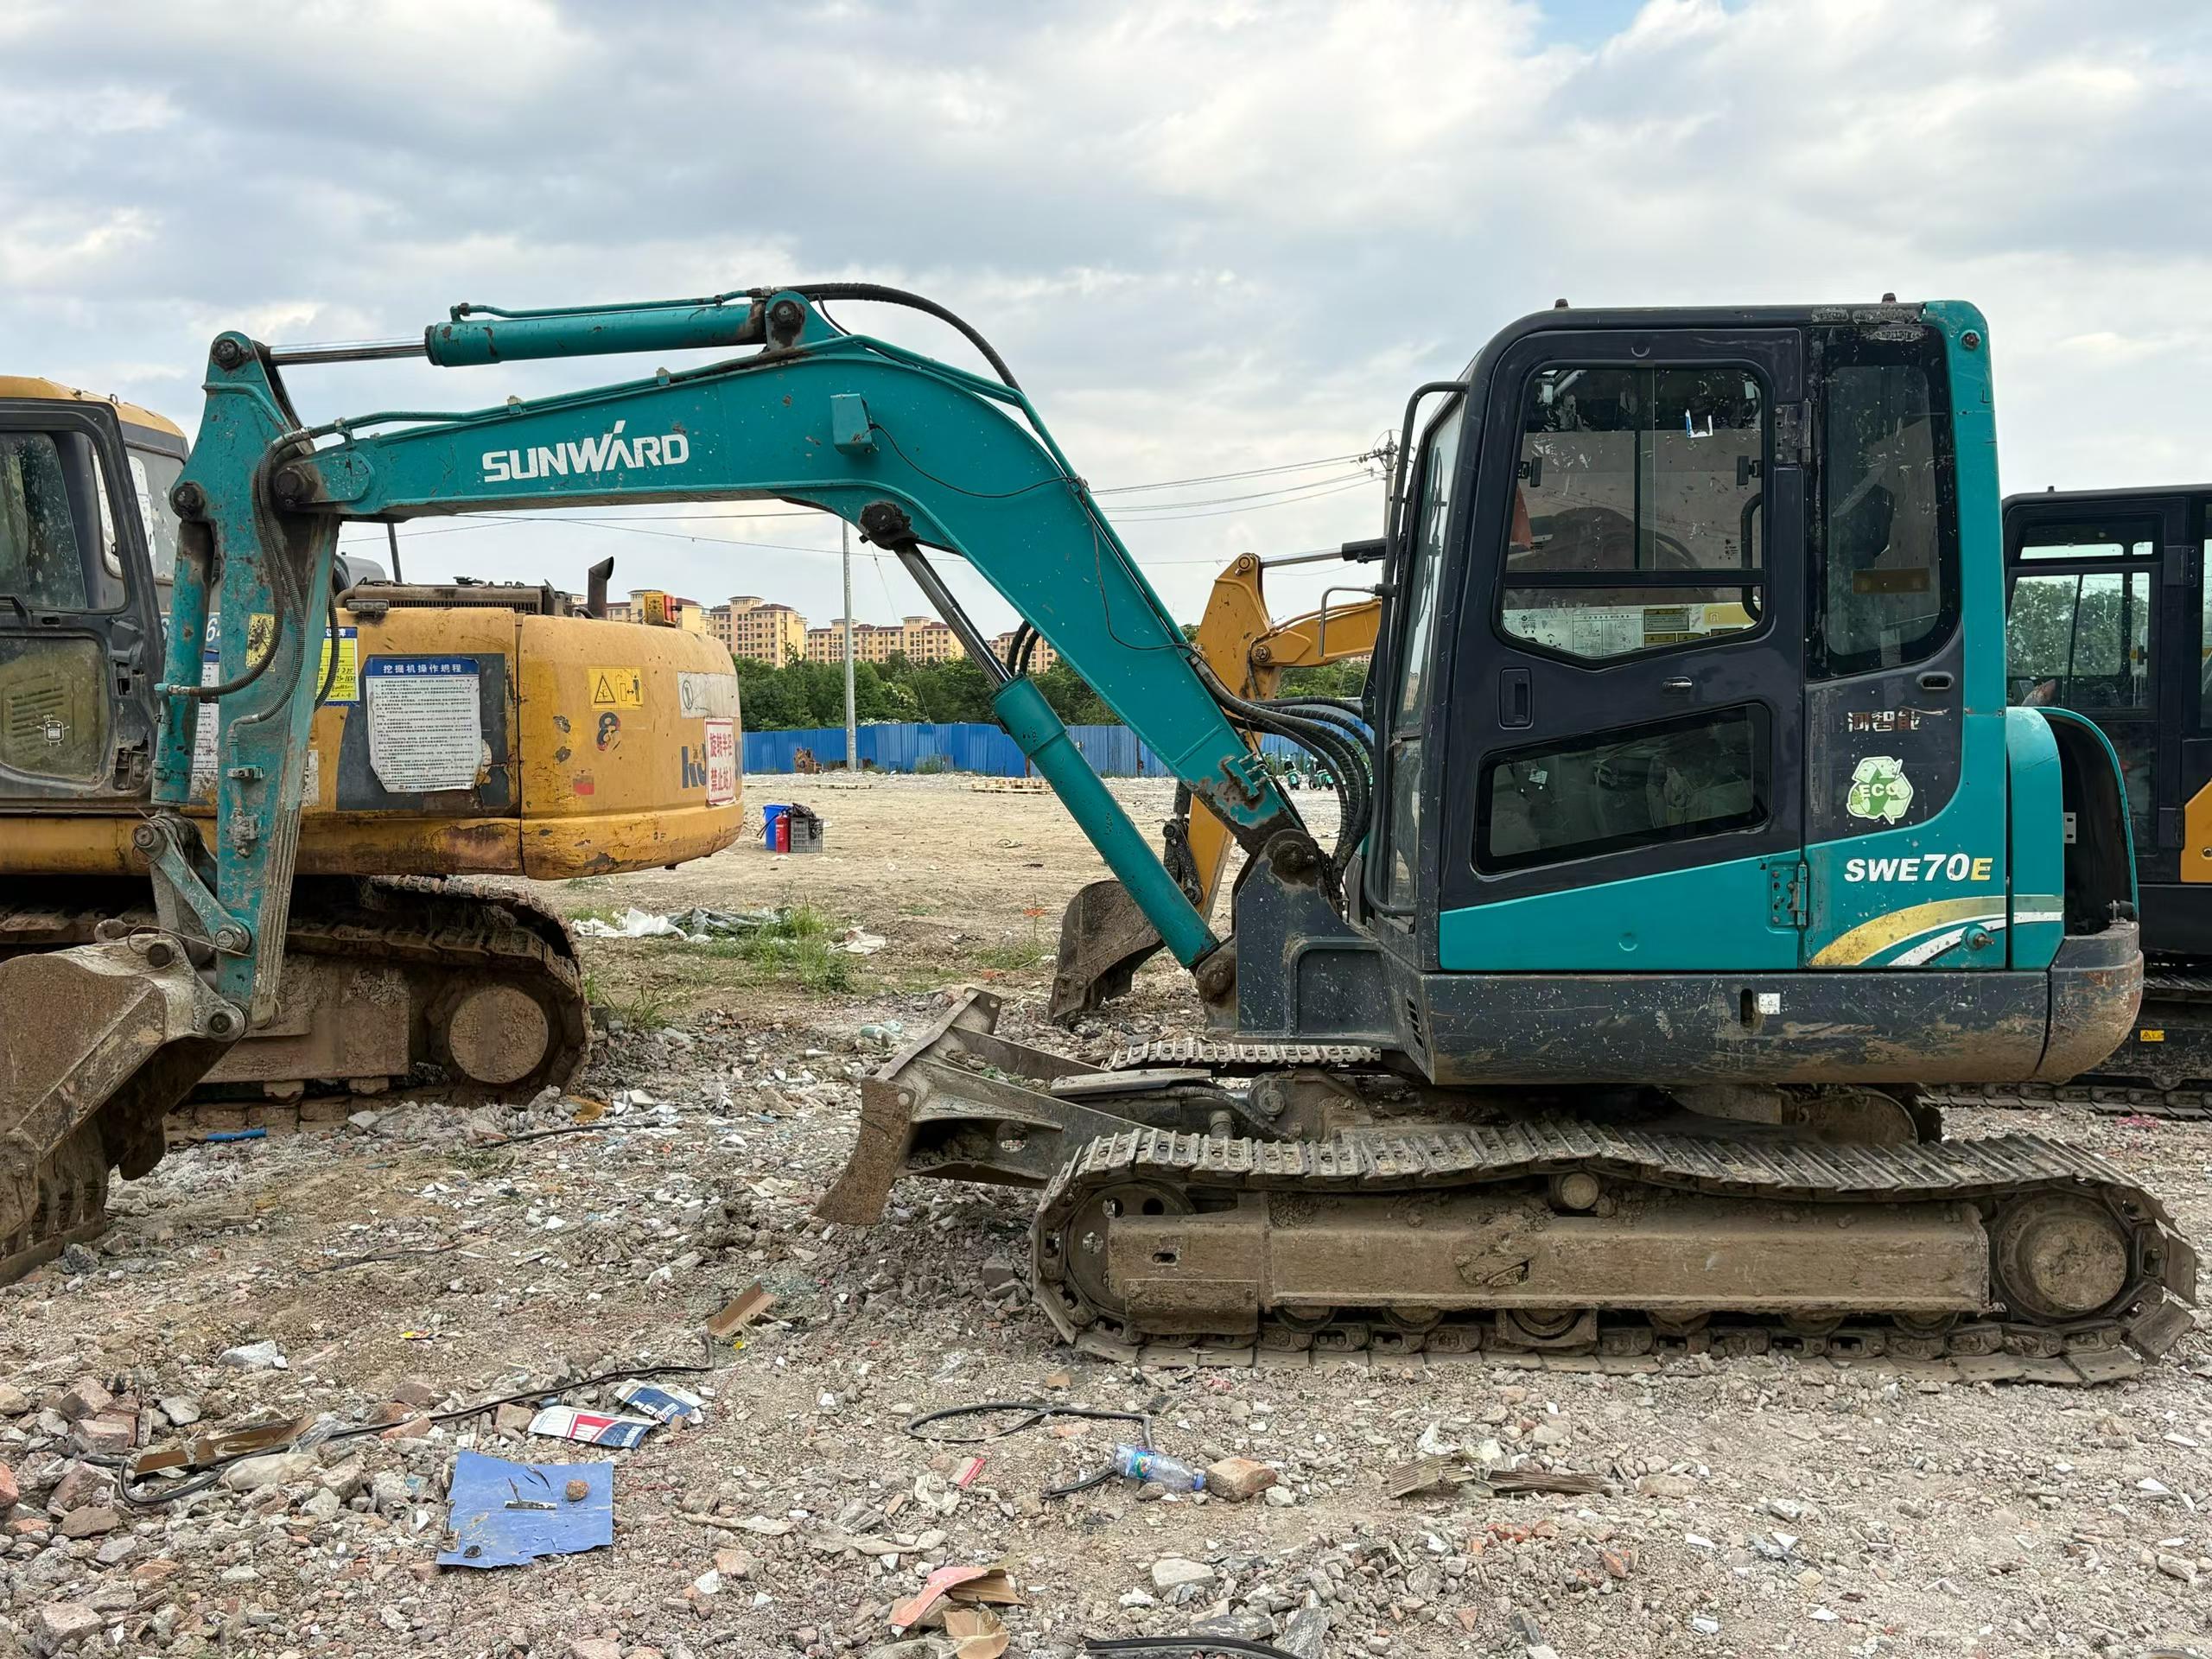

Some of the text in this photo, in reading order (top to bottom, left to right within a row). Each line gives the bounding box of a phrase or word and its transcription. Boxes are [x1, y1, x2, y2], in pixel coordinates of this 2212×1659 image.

[482, 420, 690, 482] SUNWARD
[383, 664, 462, 674] 挖掘机操作规程
[1859, 782, 1898, 798] ECO
[1844, 853, 1993, 882] SWE70E
